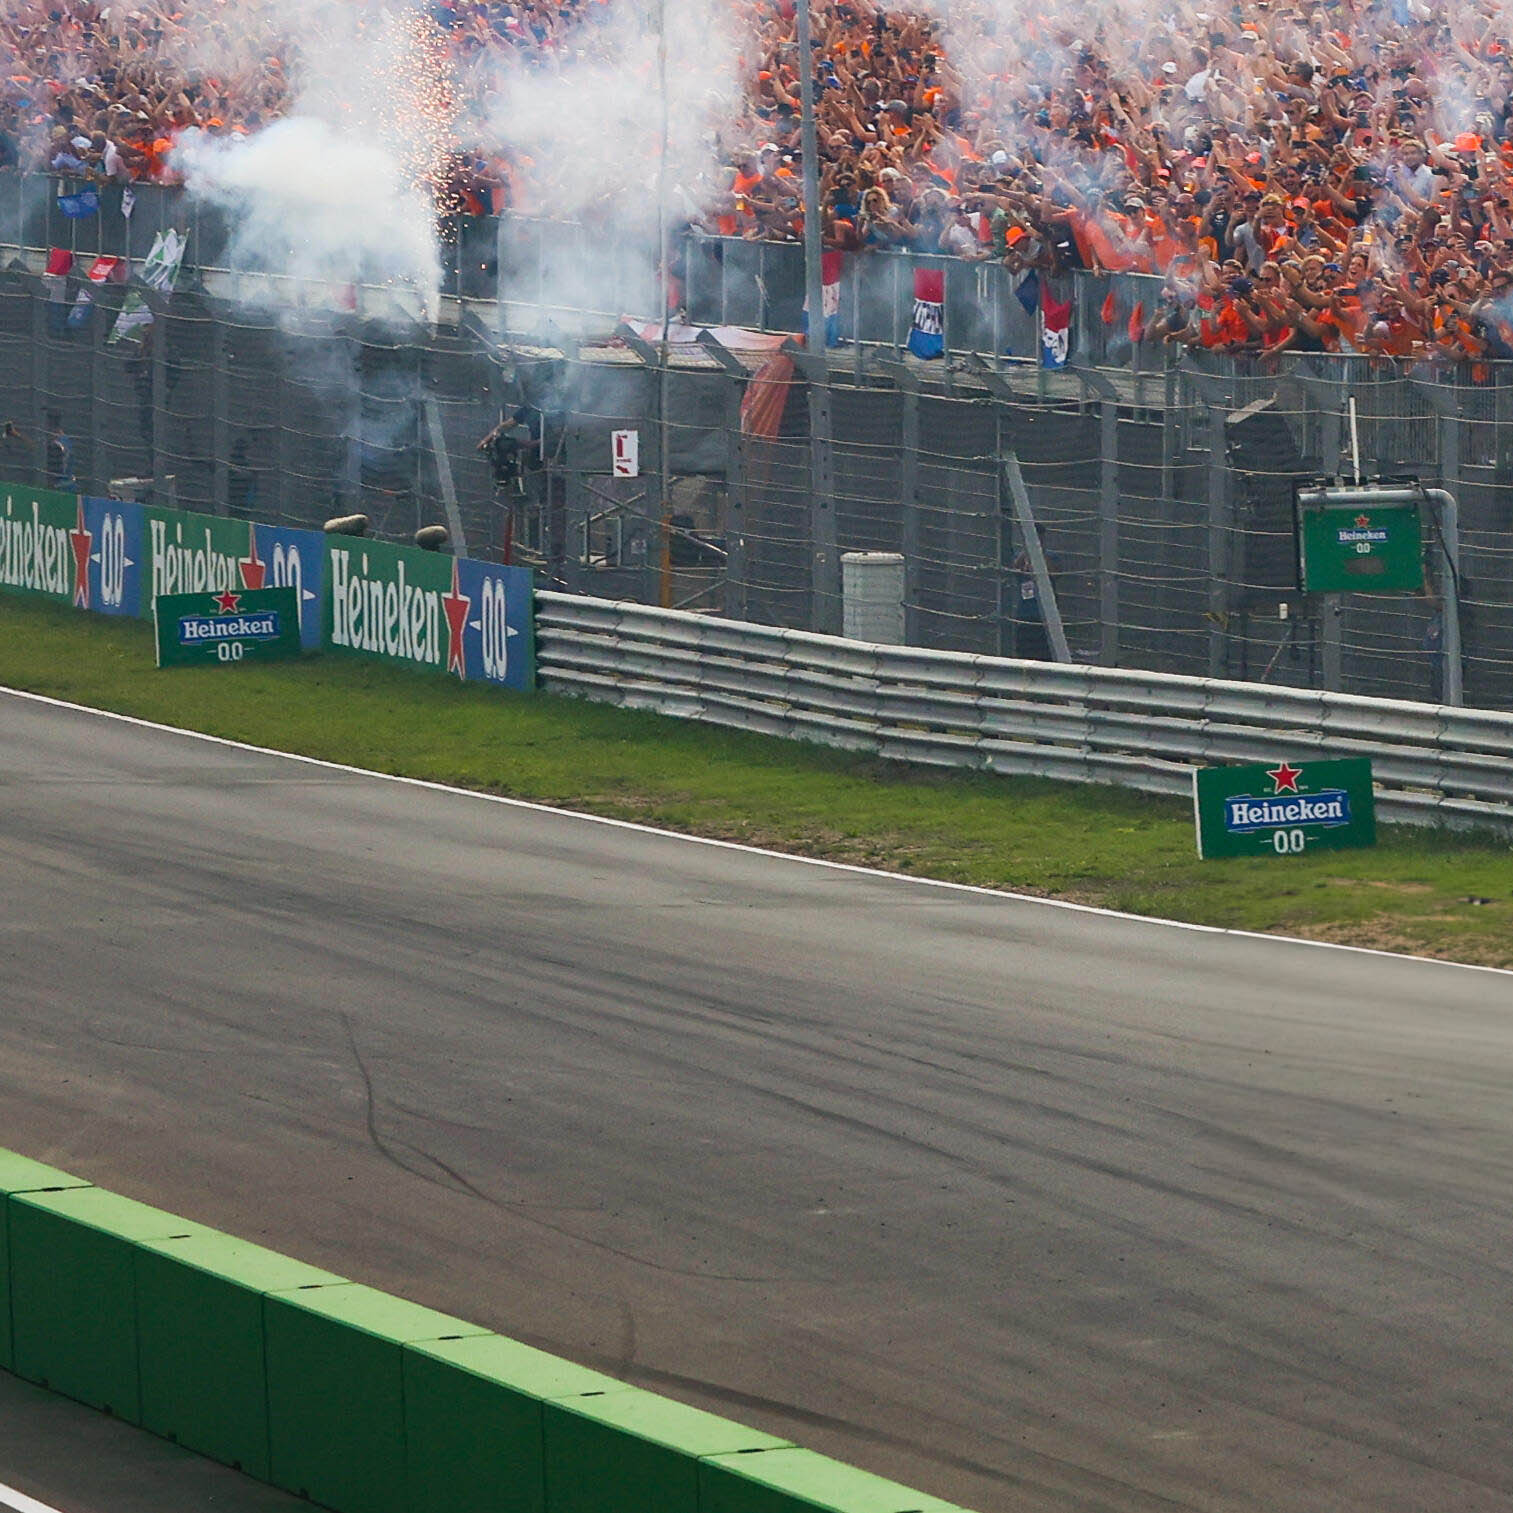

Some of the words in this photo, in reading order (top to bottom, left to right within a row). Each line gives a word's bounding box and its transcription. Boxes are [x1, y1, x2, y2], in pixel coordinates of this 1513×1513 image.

[0, 495, 69, 595] eineken
[1338, 530, 1387, 542] Heineken
[330, 548, 440, 665] Heineken
[183, 617, 274, 640] Heineken
[1230, 798, 1344, 825] Heineken
[1273, 828, 1305, 854] 0.0
